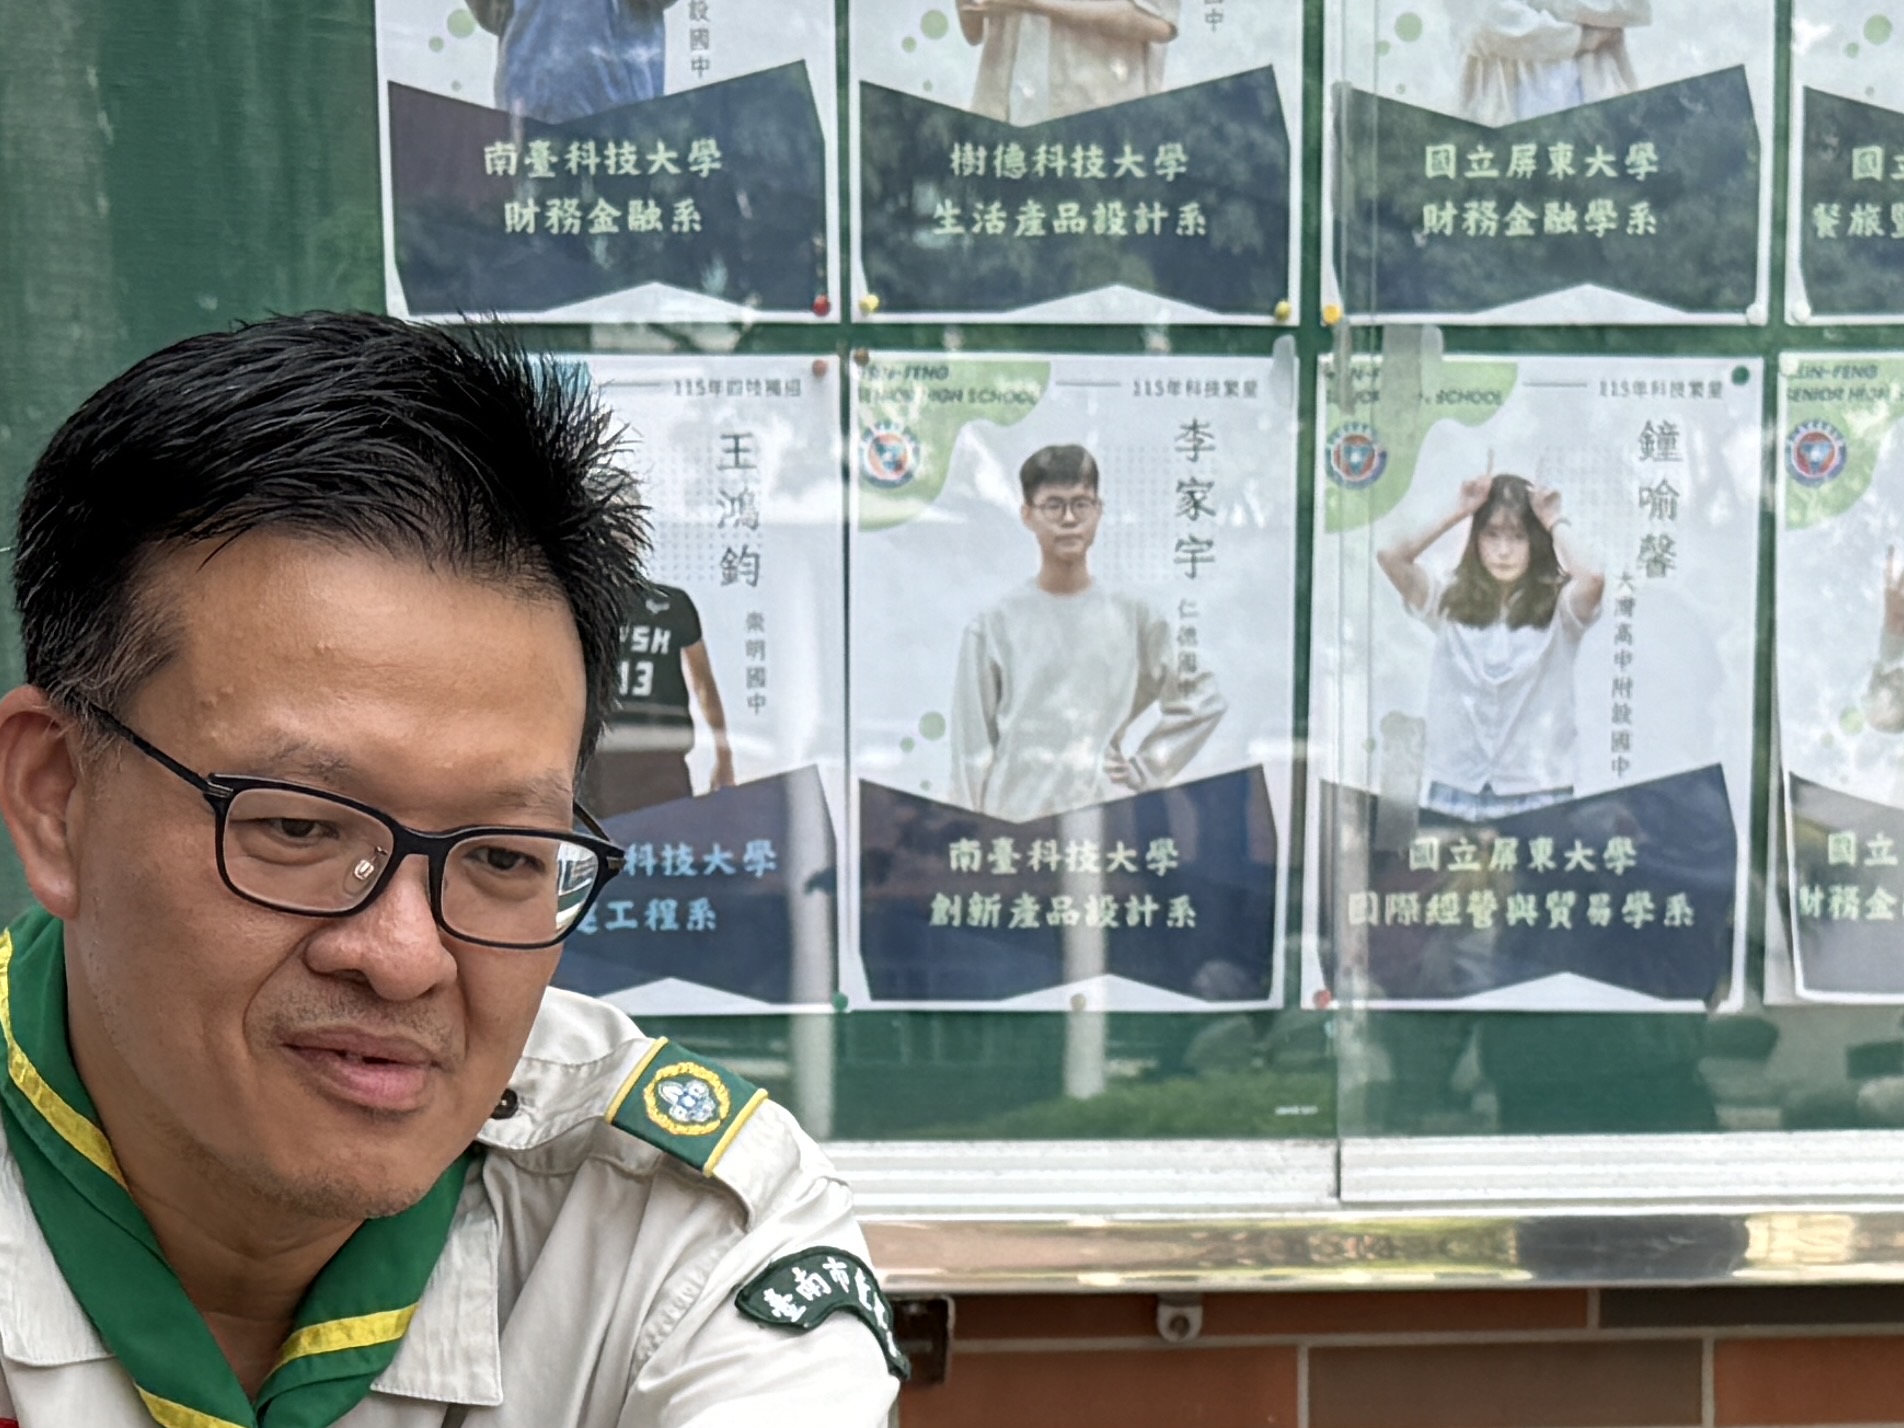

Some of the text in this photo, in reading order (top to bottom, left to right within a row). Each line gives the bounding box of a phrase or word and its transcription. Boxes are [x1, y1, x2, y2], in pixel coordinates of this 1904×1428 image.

[484, 139, 723, 178] 南臺科技大學
[950, 141, 1190, 182] 樹德科技大學
[1425, 142, 1660, 182] 國立屏東大學
[504, 198, 702, 235] 財務金融系
[933, 200, 1207, 238] 生活產品設計系
[1422, 200, 1657, 238] 財務金融學系
[717, 431, 761, 588] 王鴻鈞
[1172, 417, 1217, 580] 李家宇
[948, 836, 1180, 876] 南臺科技大學
[1409, 836, 1637, 876] 國立屏東大學
[929, 892, 1197, 930] 創新產品設計系
[1348, 890, 1695, 930] 國際經營與貿易學系
